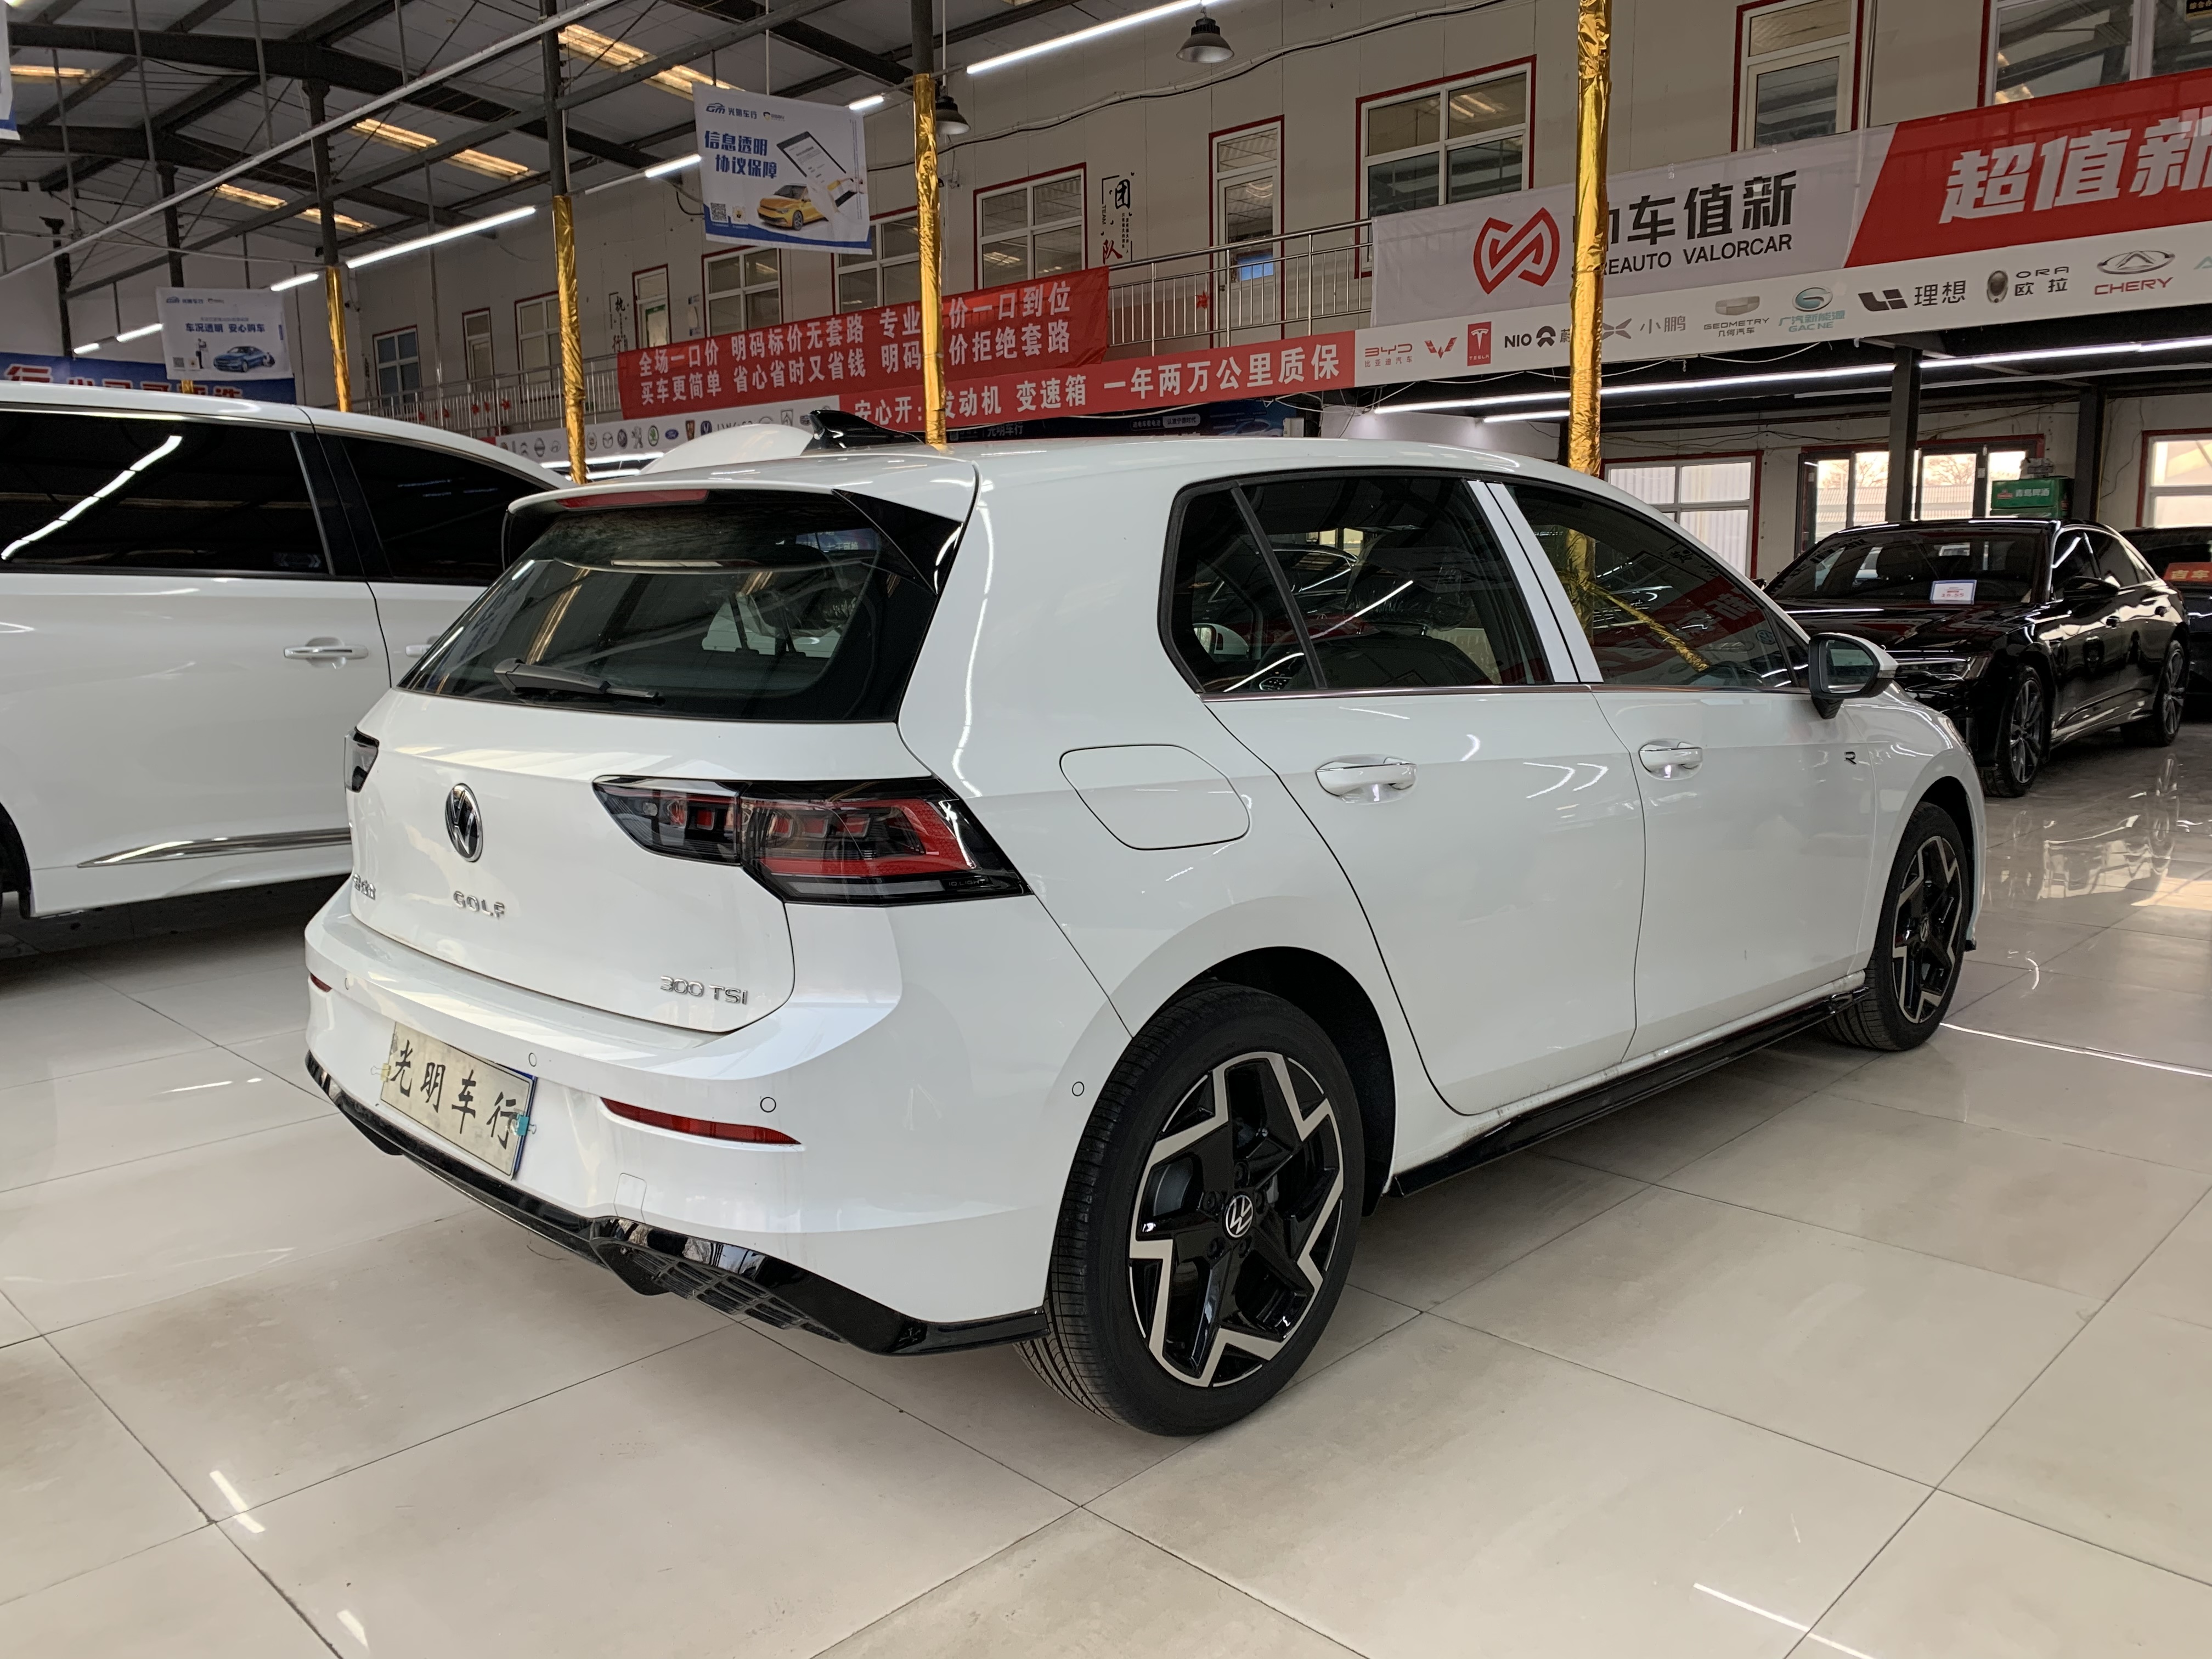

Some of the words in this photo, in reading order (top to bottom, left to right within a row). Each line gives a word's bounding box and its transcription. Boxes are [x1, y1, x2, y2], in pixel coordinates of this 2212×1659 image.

[704, 131, 768, 156] 信息透明
[715, 154, 777, 179] 协议保障
[1938, 113, 2212, 224] 超值新
[1115, 179, 1131, 210] 团
[1103, 239, 1123, 265] 队
[1571, 251, 1672, 278] EAUTO
[1683, 233, 1792, 264] VALORCAR
[2015, 266, 2070, 278] ORA
[1914, 280, 1966, 307] 理想
[2015, 278, 2068, 296] 欧拉
[2094, 276, 2174, 296] CHERY
[185, 323, 224, 332] 车况透明
[228, 323, 266, 332] 安心购车
[639, 339, 719, 377] 全场一口价
[731, 313, 864, 362] 明码标价无套路
[879, 280, 1070, 339] 专业价一口到位
[1640, 315, 1686, 334] 小鹏
[1703, 317, 1770, 330] GEOMETRY
[1778, 310, 1846, 326] 广汽新能源
[1788, 323, 1816, 332] GAC
[1817, 321, 1834, 330] NE
[1504, 333, 1532, 348] NIO
[1718, 327, 1756, 337] 几何汽车
[1364, 343, 1413, 357] BYD
[641, 370, 721, 406] 买车更简单
[733, 348, 866, 393] 省心省时又省钱
[881, 319, 1070, 374] 明码价拒绝套路
[1364, 356, 1413, 368] 比亚迪汽车
[1015, 374, 1087, 413] 变速箱
[1104, 343, 1339, 399] 一年两万公里质保
[1844, 751, 1857, 765] R
[453, 890, 505, 919] GOLF
[660, 975, 704, 998] 300
[708, 984, 748, 1005] TSI
[389, 1039, 517, 1150] 光明车行
